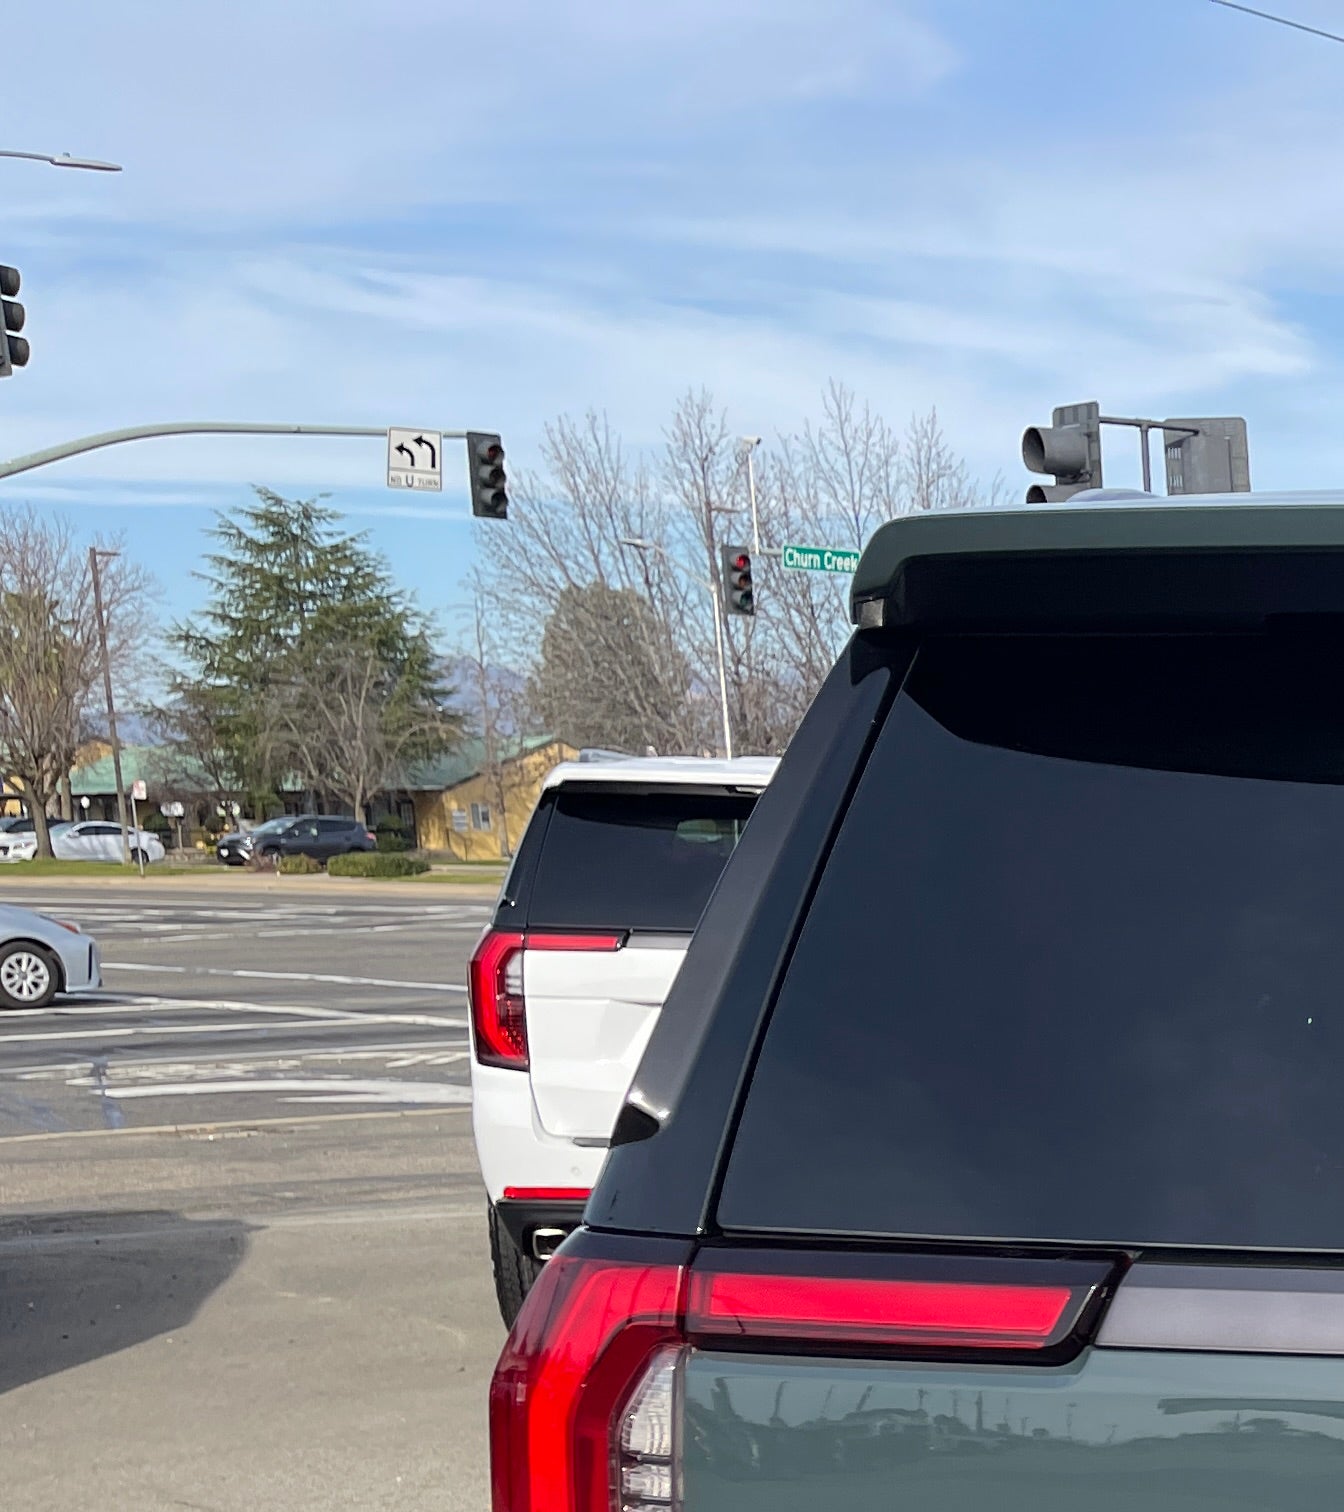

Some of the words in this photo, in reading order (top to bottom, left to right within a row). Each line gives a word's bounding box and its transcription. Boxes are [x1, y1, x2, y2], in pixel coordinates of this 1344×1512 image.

[405, 474, 414, 488] U
[785, 547, 821, 569] Churn
[823, 551, 859, 572] Creek
